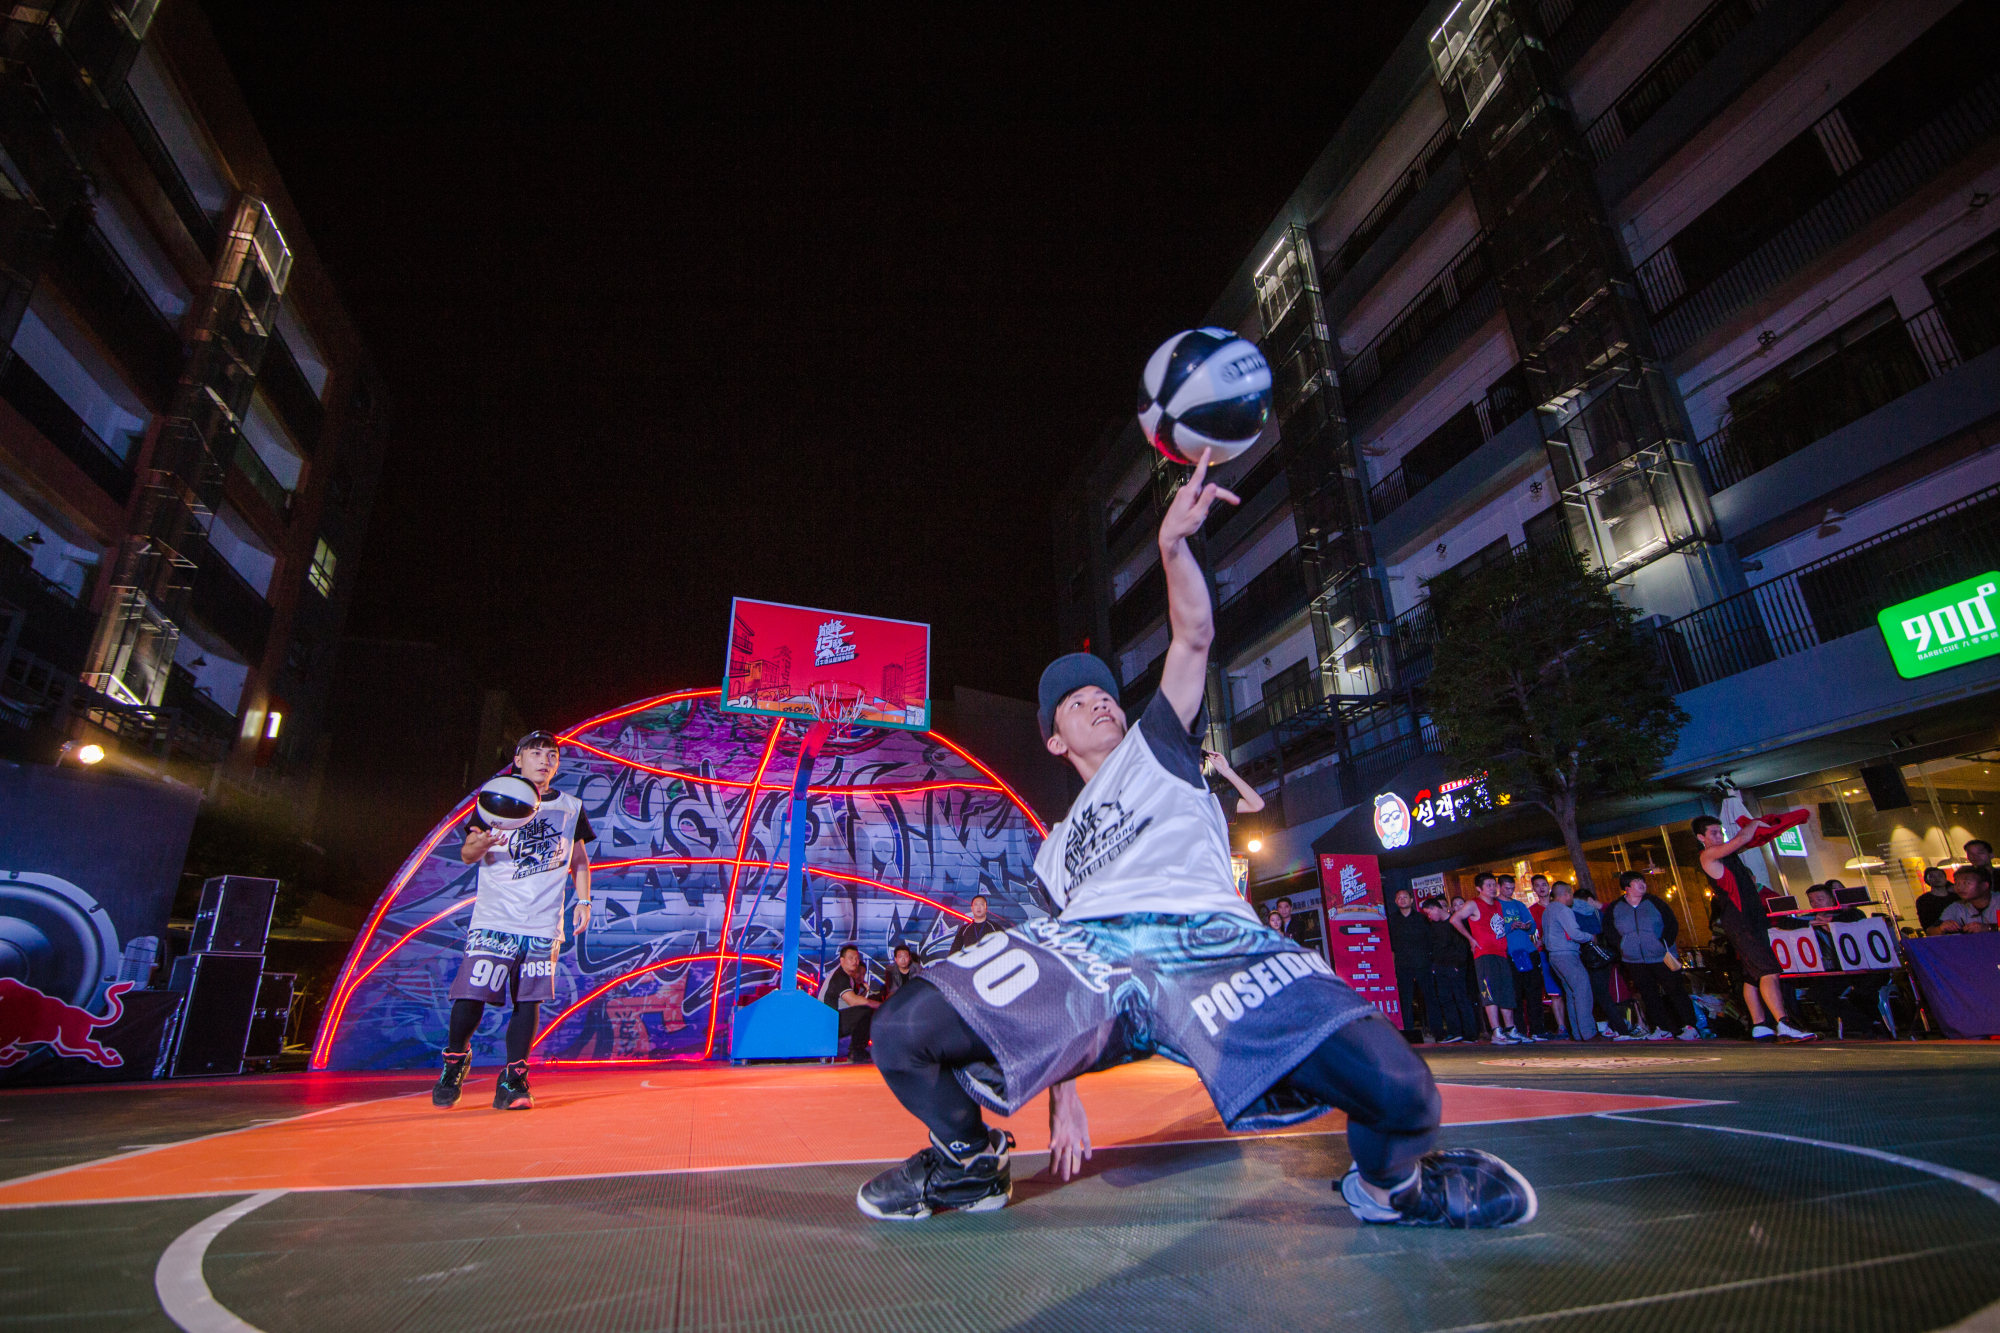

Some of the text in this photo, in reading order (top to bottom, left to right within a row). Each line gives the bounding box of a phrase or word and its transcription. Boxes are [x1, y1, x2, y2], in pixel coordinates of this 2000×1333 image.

[835, 644, 856, 654] TOP
[1917, 643, 1960, 661] BARBECUE
[1094, 821, 1135, 856] second
[539, 849, 564, 861] TOP
[1417, 884, 1444, 899] OPEN
[469, 959, 509, 993] 90
